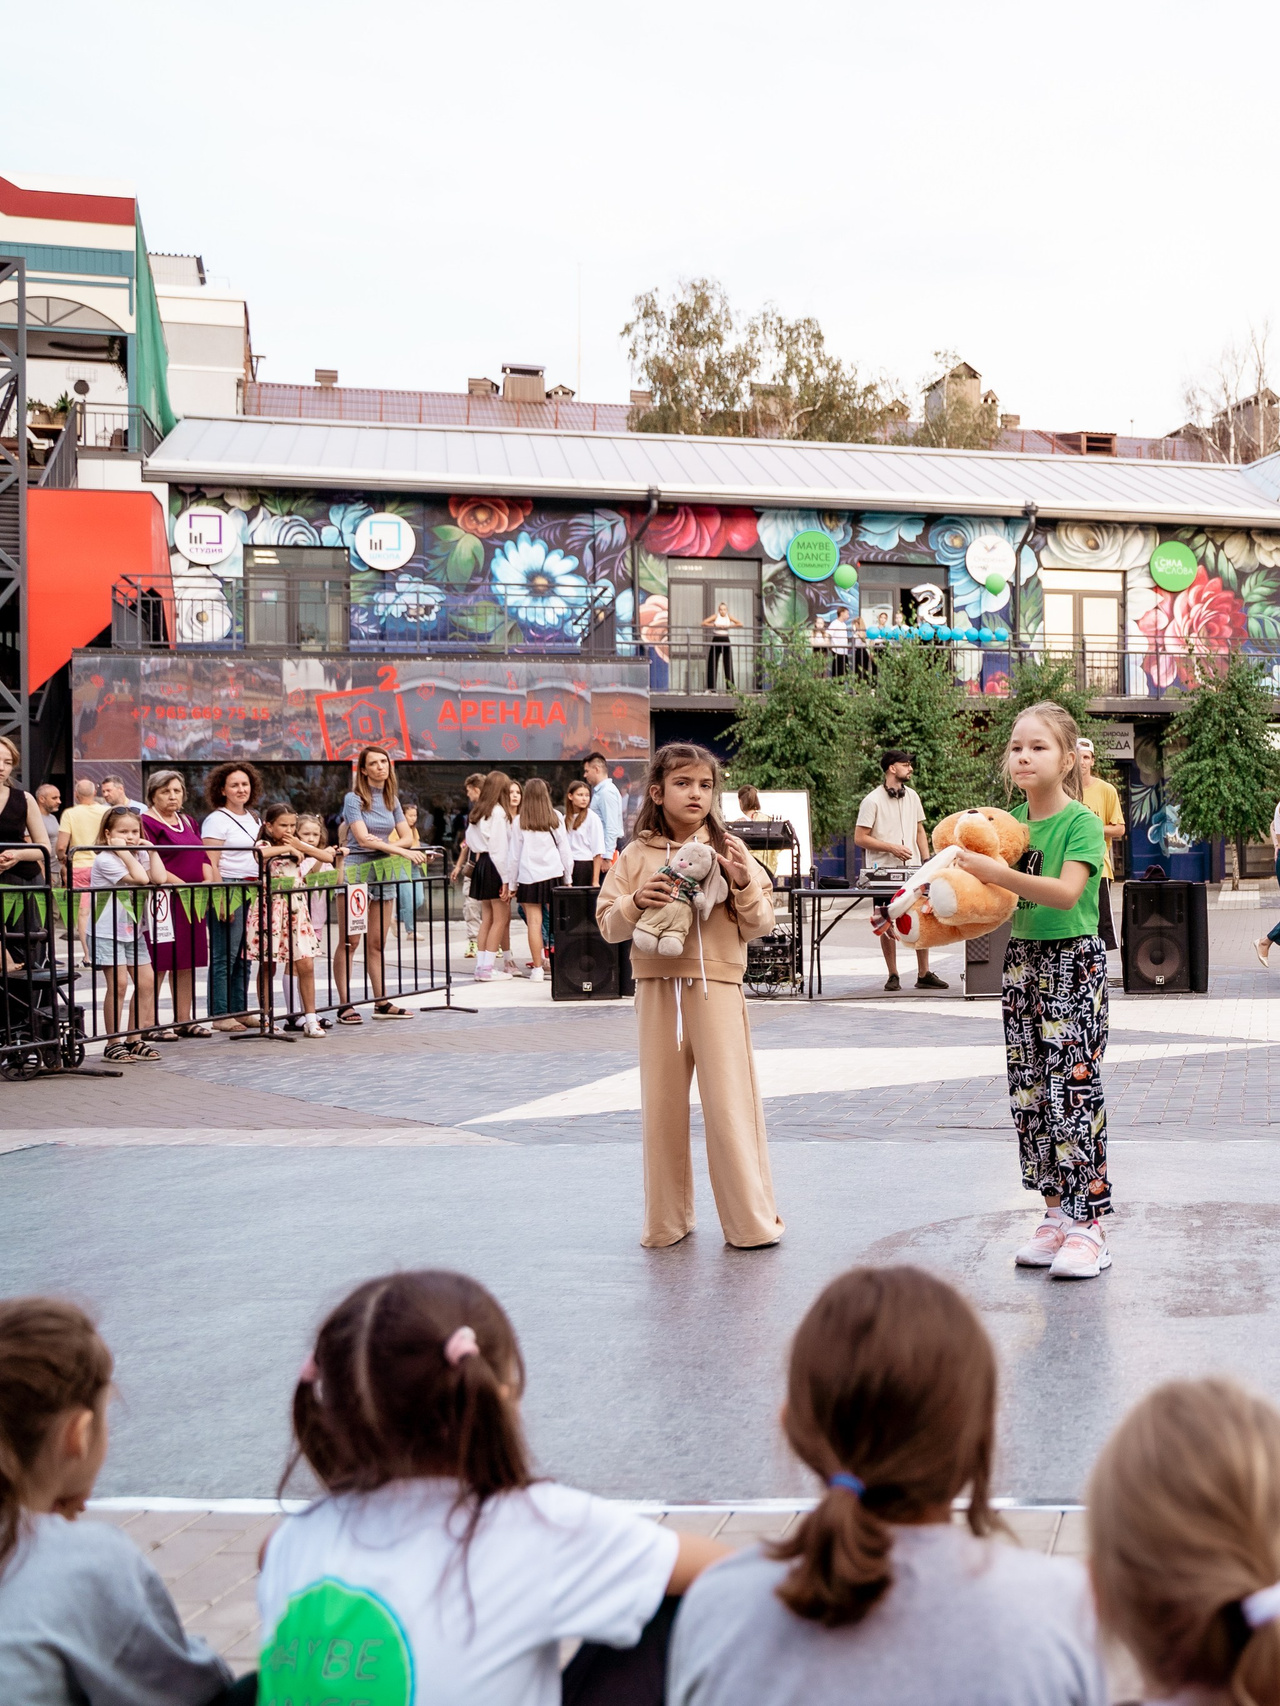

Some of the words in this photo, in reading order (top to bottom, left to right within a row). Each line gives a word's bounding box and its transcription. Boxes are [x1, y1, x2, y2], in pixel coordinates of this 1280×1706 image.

[796, 541, 831, 550] MAYBE
[796, 552, 831, 561] DANCE
[1160, 559, 1182, 567] СИЛА
[1164, 567, 1193, 575] СЛОВА
[131, 705, 151, 719] +7
[155, 705, 187, 719] 965
[191, 706, 223, 719] 669
[227, 707, 246, 720] 75
[251, 707, 270, 720] 15
[438, 700, 567, 728] АРЕНДА
